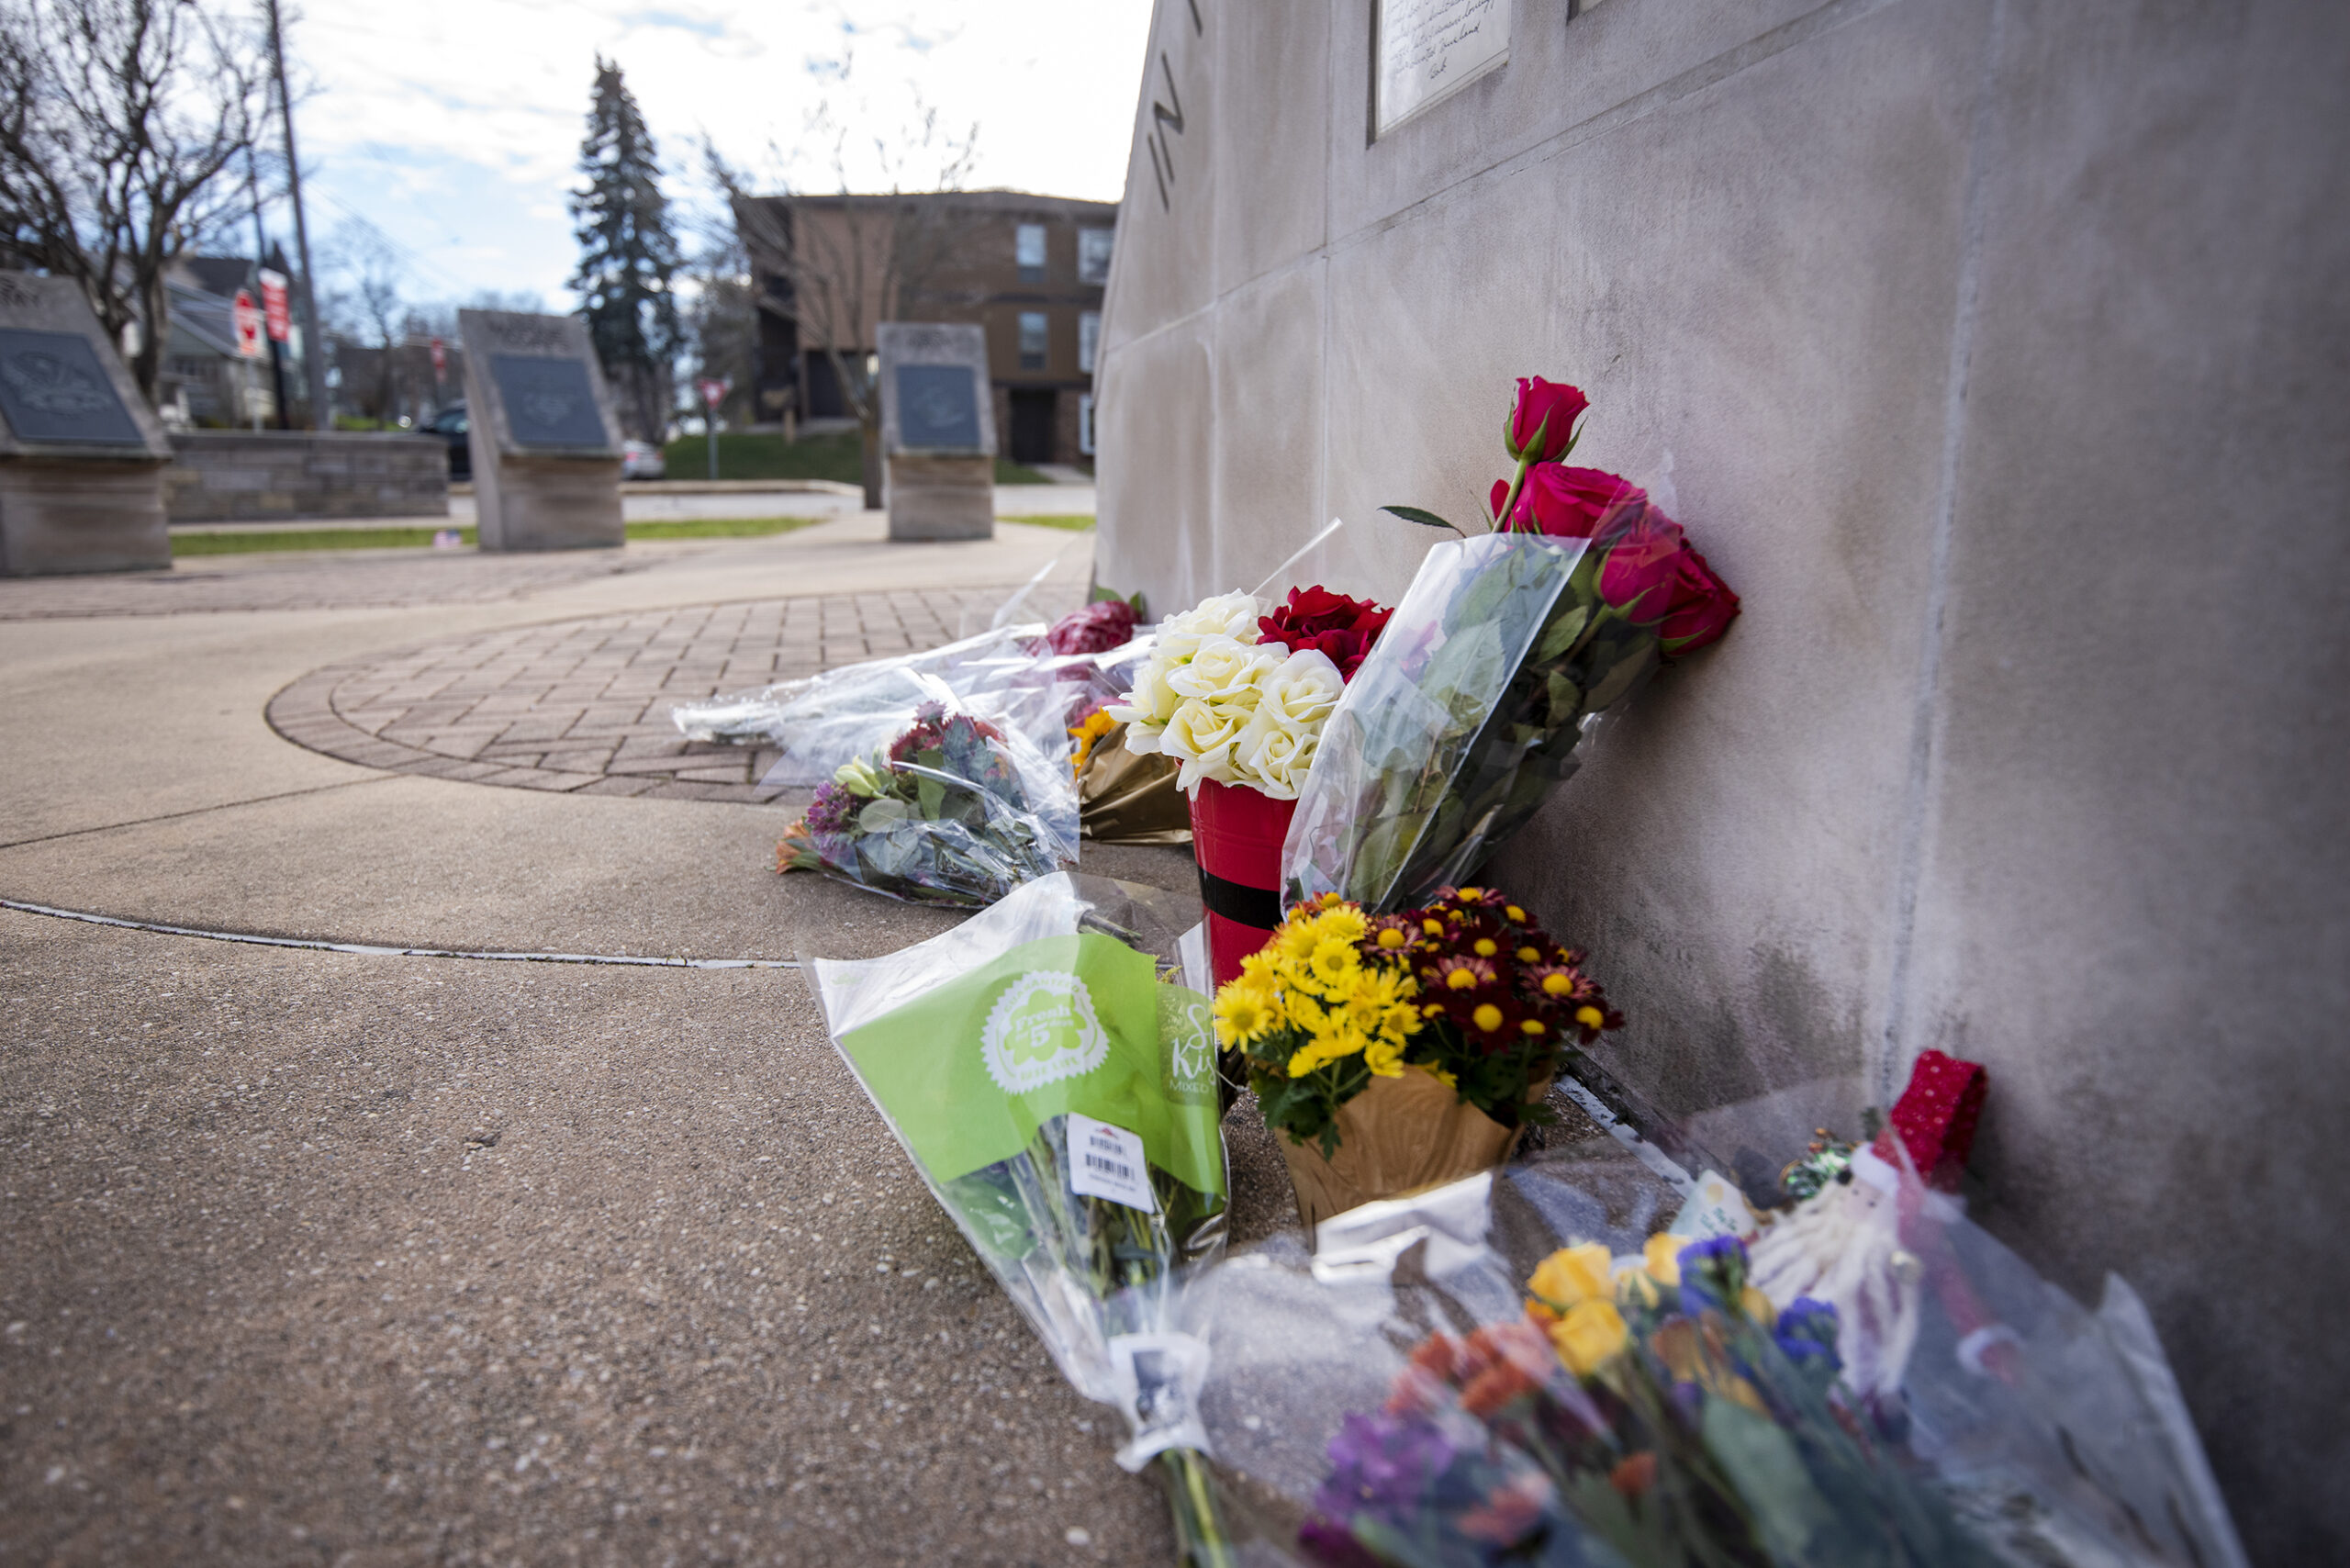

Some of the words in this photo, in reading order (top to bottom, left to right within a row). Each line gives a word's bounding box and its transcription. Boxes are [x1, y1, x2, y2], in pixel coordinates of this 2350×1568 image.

[1015, 1003, 1073, 1032] Fresh
[1030, 1022, 1051, 1048] 5
[1169, 1079, 1210, 1094] MIXED
